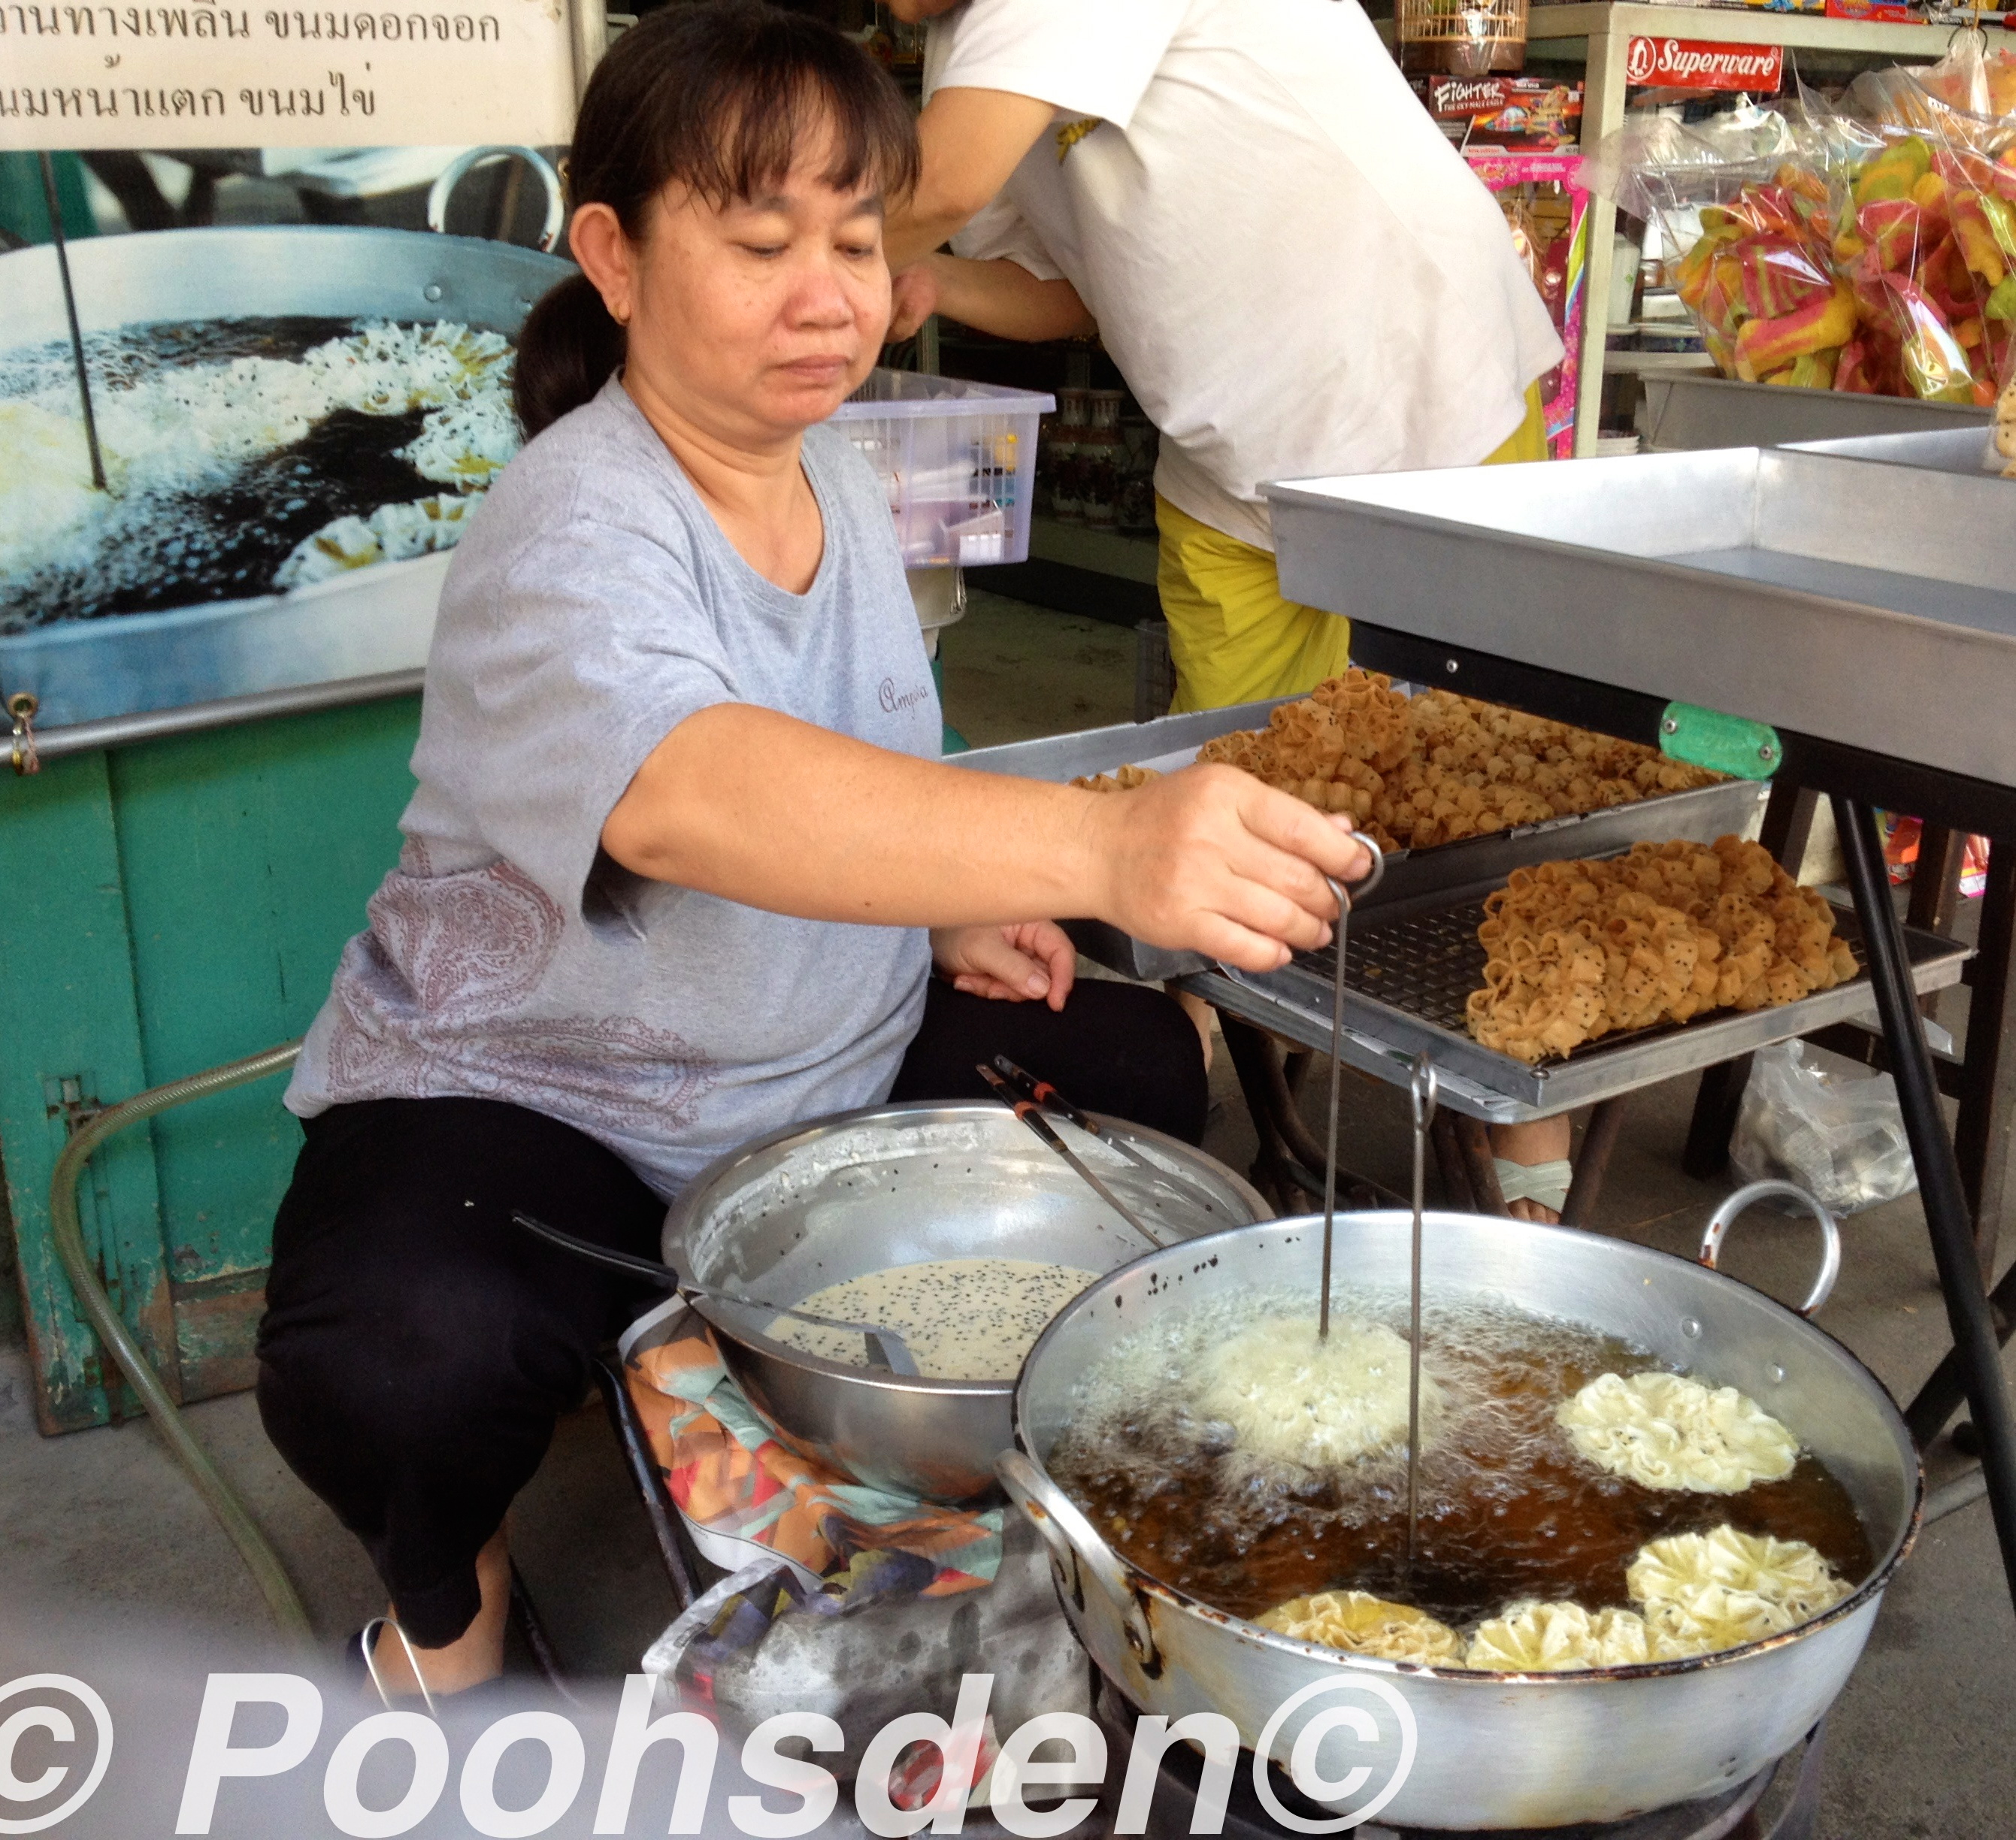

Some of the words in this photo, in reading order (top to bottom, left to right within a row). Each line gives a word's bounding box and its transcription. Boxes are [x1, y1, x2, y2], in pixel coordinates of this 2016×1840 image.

[265, 10, 500, 41] ขนมดอกจอก
[1657, 39, 1775, 78] Superware
[240, 62, 375, 116] ขนมไข่
